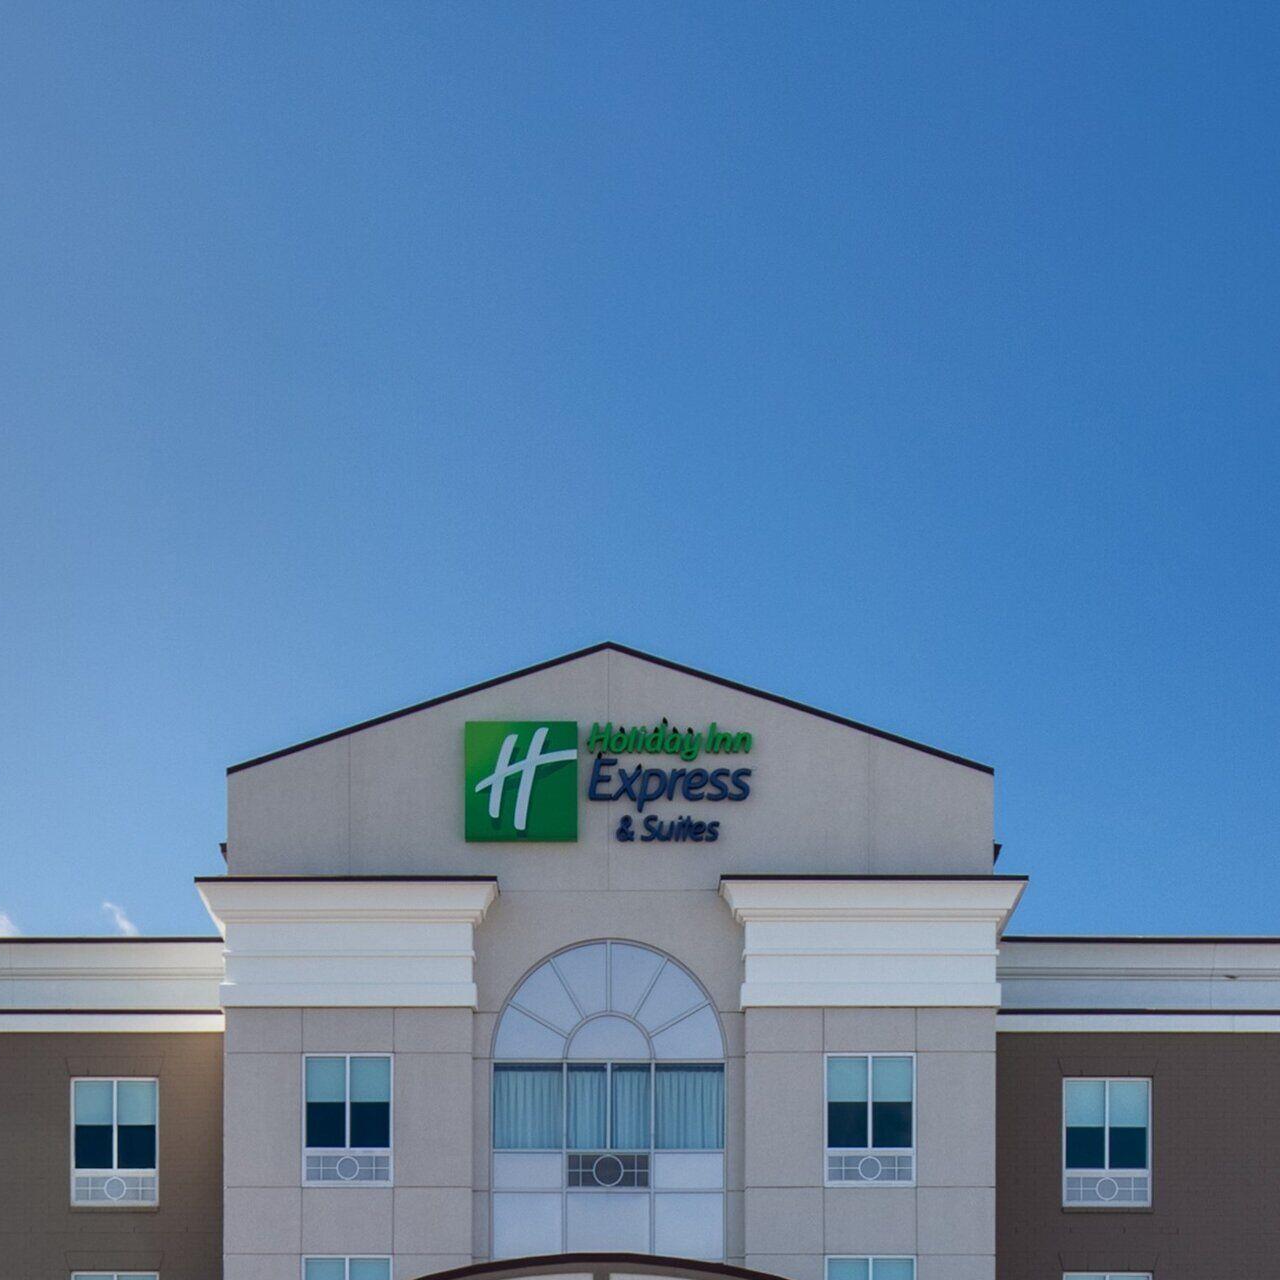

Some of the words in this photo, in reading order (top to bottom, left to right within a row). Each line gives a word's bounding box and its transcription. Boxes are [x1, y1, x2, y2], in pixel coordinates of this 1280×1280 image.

[587, 722, 702, 762] Holiday
[705, 722, 753, 754] Inn
[475, 727, 577, 831] H
[588, 758, 752, 813] Express
[616, 816, 635, 842] &
[641, 815, 720, 842] Suites
